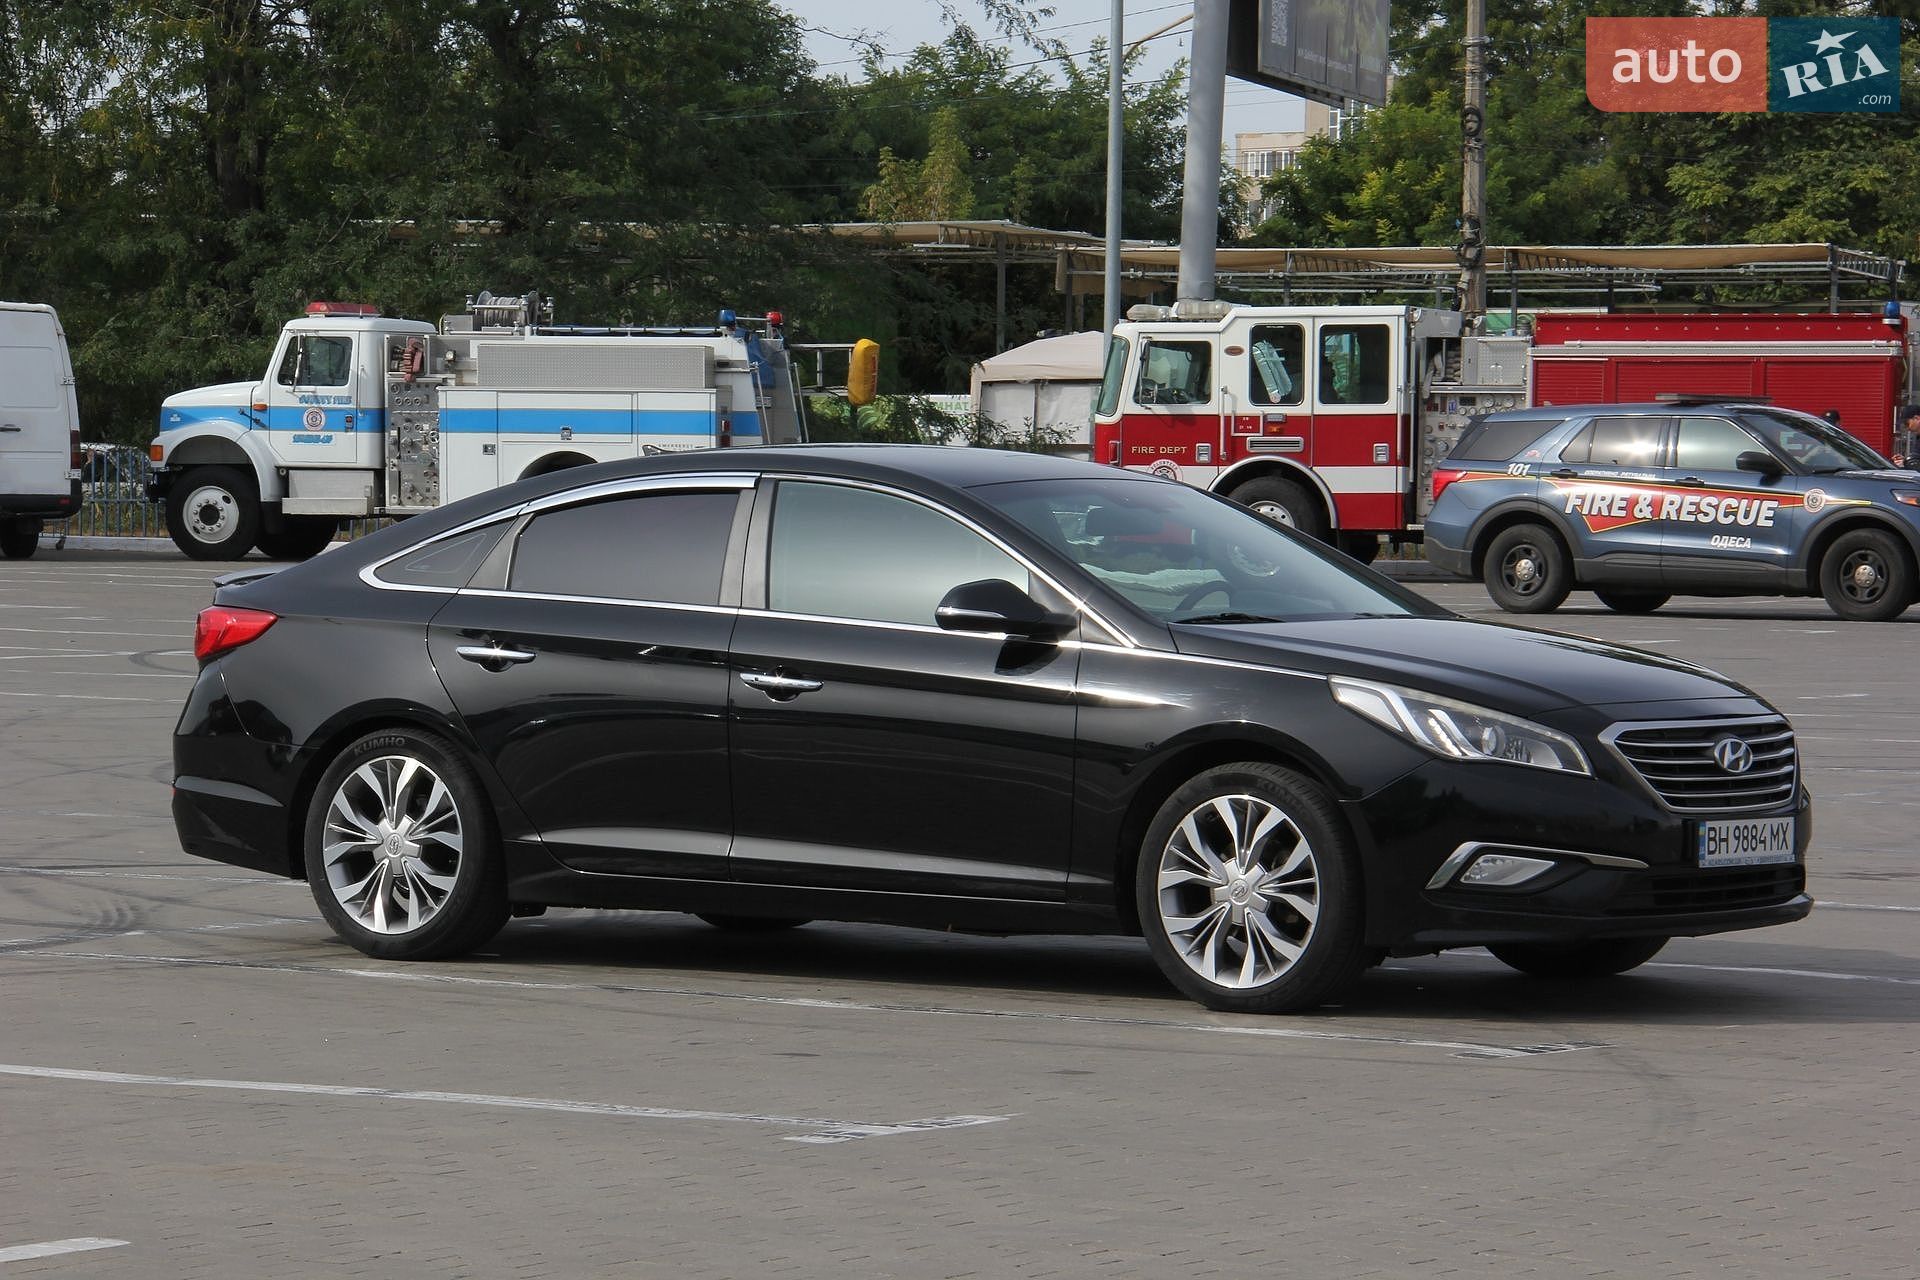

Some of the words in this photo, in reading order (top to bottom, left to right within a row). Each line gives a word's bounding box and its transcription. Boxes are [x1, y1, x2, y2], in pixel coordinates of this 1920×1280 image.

[1131, 446, 1156, 454] FIRE
[1159, 446, 1187, 454] DEPT
[1507, 463, 1531, 476] 101
[1564, 491, 1628, 517] FIRE
[1633, 493, 1653, 520] &
[1659, 493, 1779, 527] RESCUE
[1710, 534, 1751, 549] ОДЕСА
[1707, 825, 1730, 856] BH
[1733, 822, 1767, 854] 9884
[1769, 821, 1789, 851] MX
